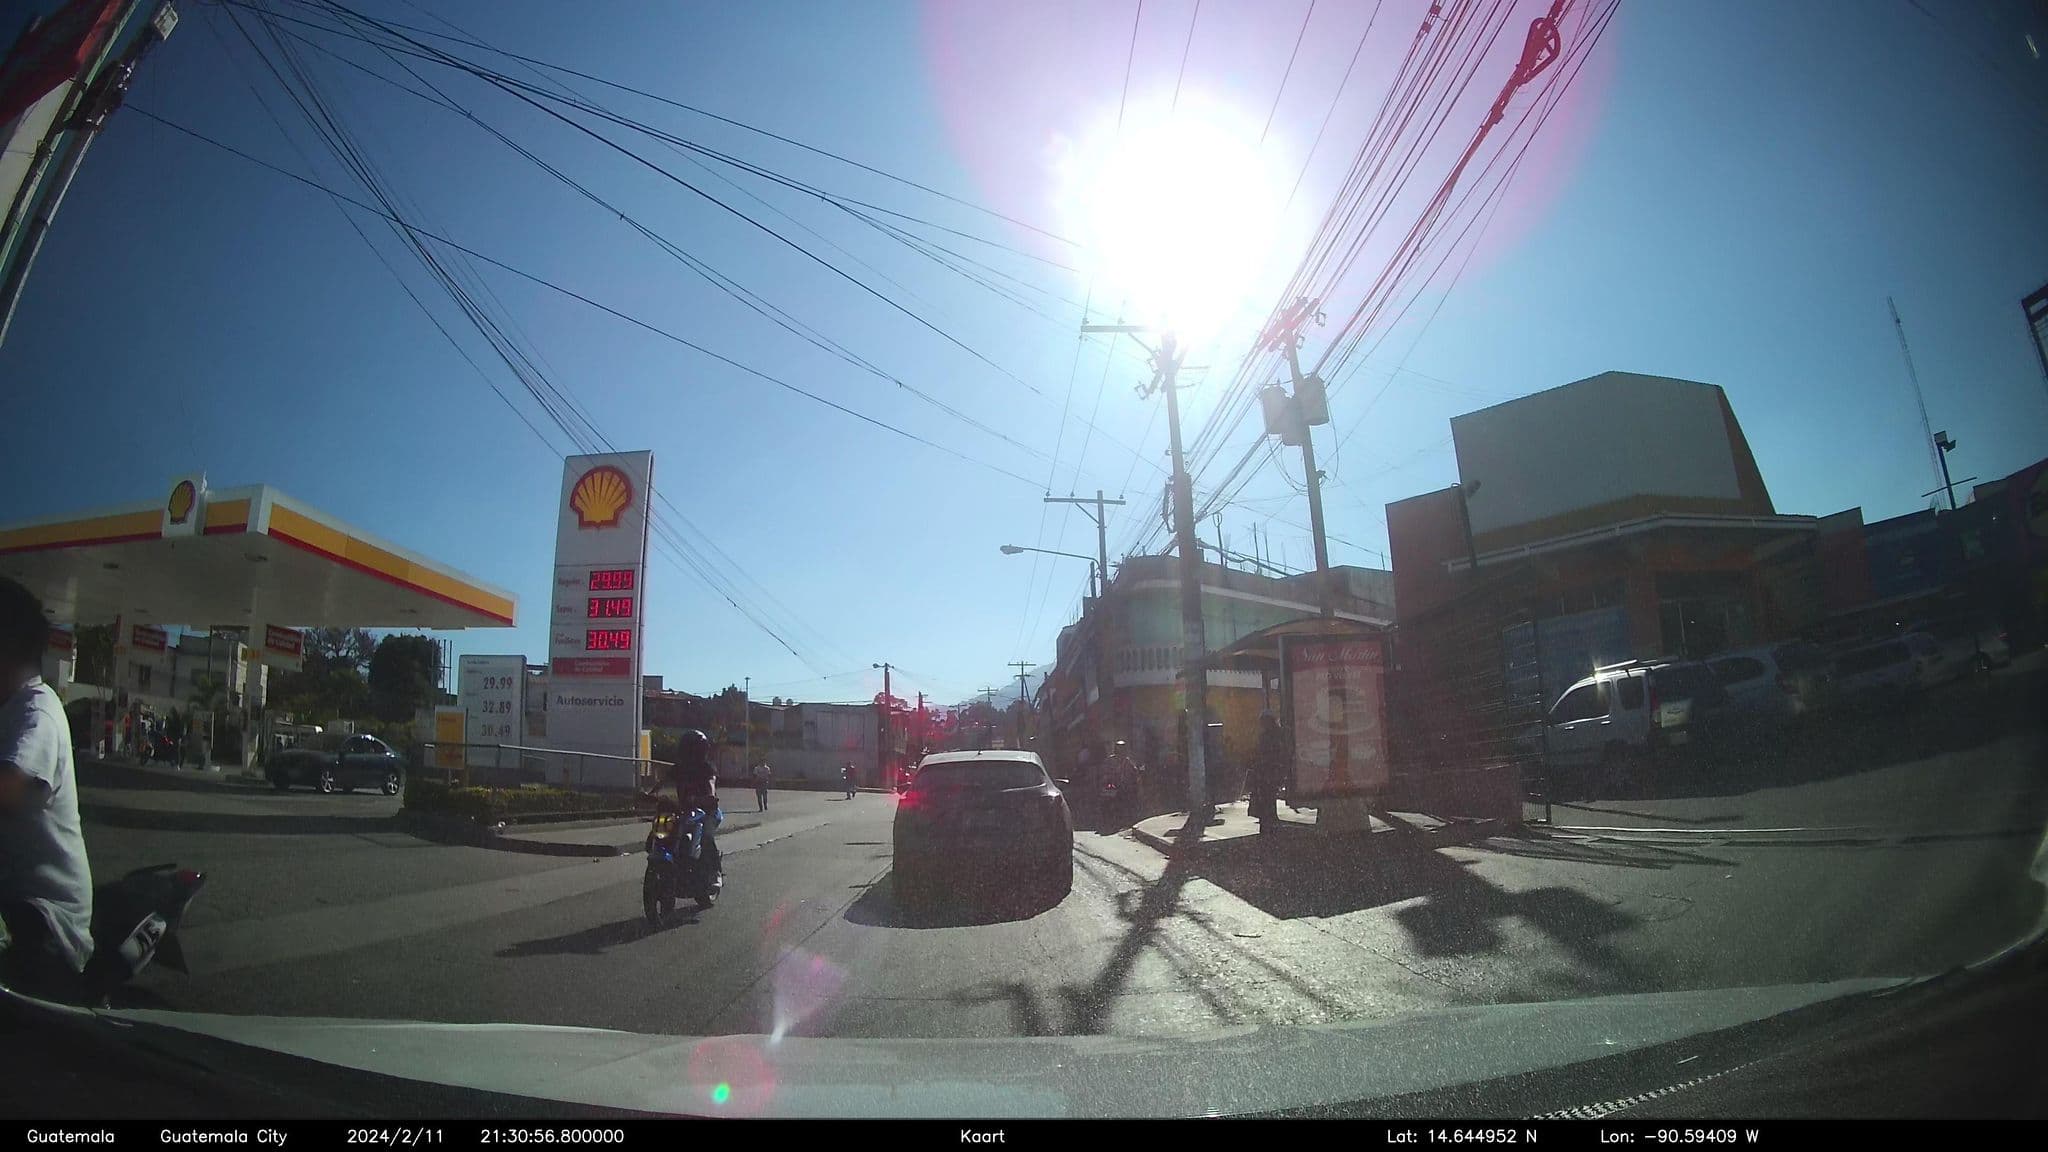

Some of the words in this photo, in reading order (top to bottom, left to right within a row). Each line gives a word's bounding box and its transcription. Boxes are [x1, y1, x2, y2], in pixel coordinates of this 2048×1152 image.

[591, 572, 633, 590] 29.99
[589, 600, 631, 616] 31.49
[588, 631, 629, 648] 30.49
[483, 676, 513, 690] 29.99
[482, 701, 512, 713] 32.89
[556, 695, 624, 706] Autoservicio
